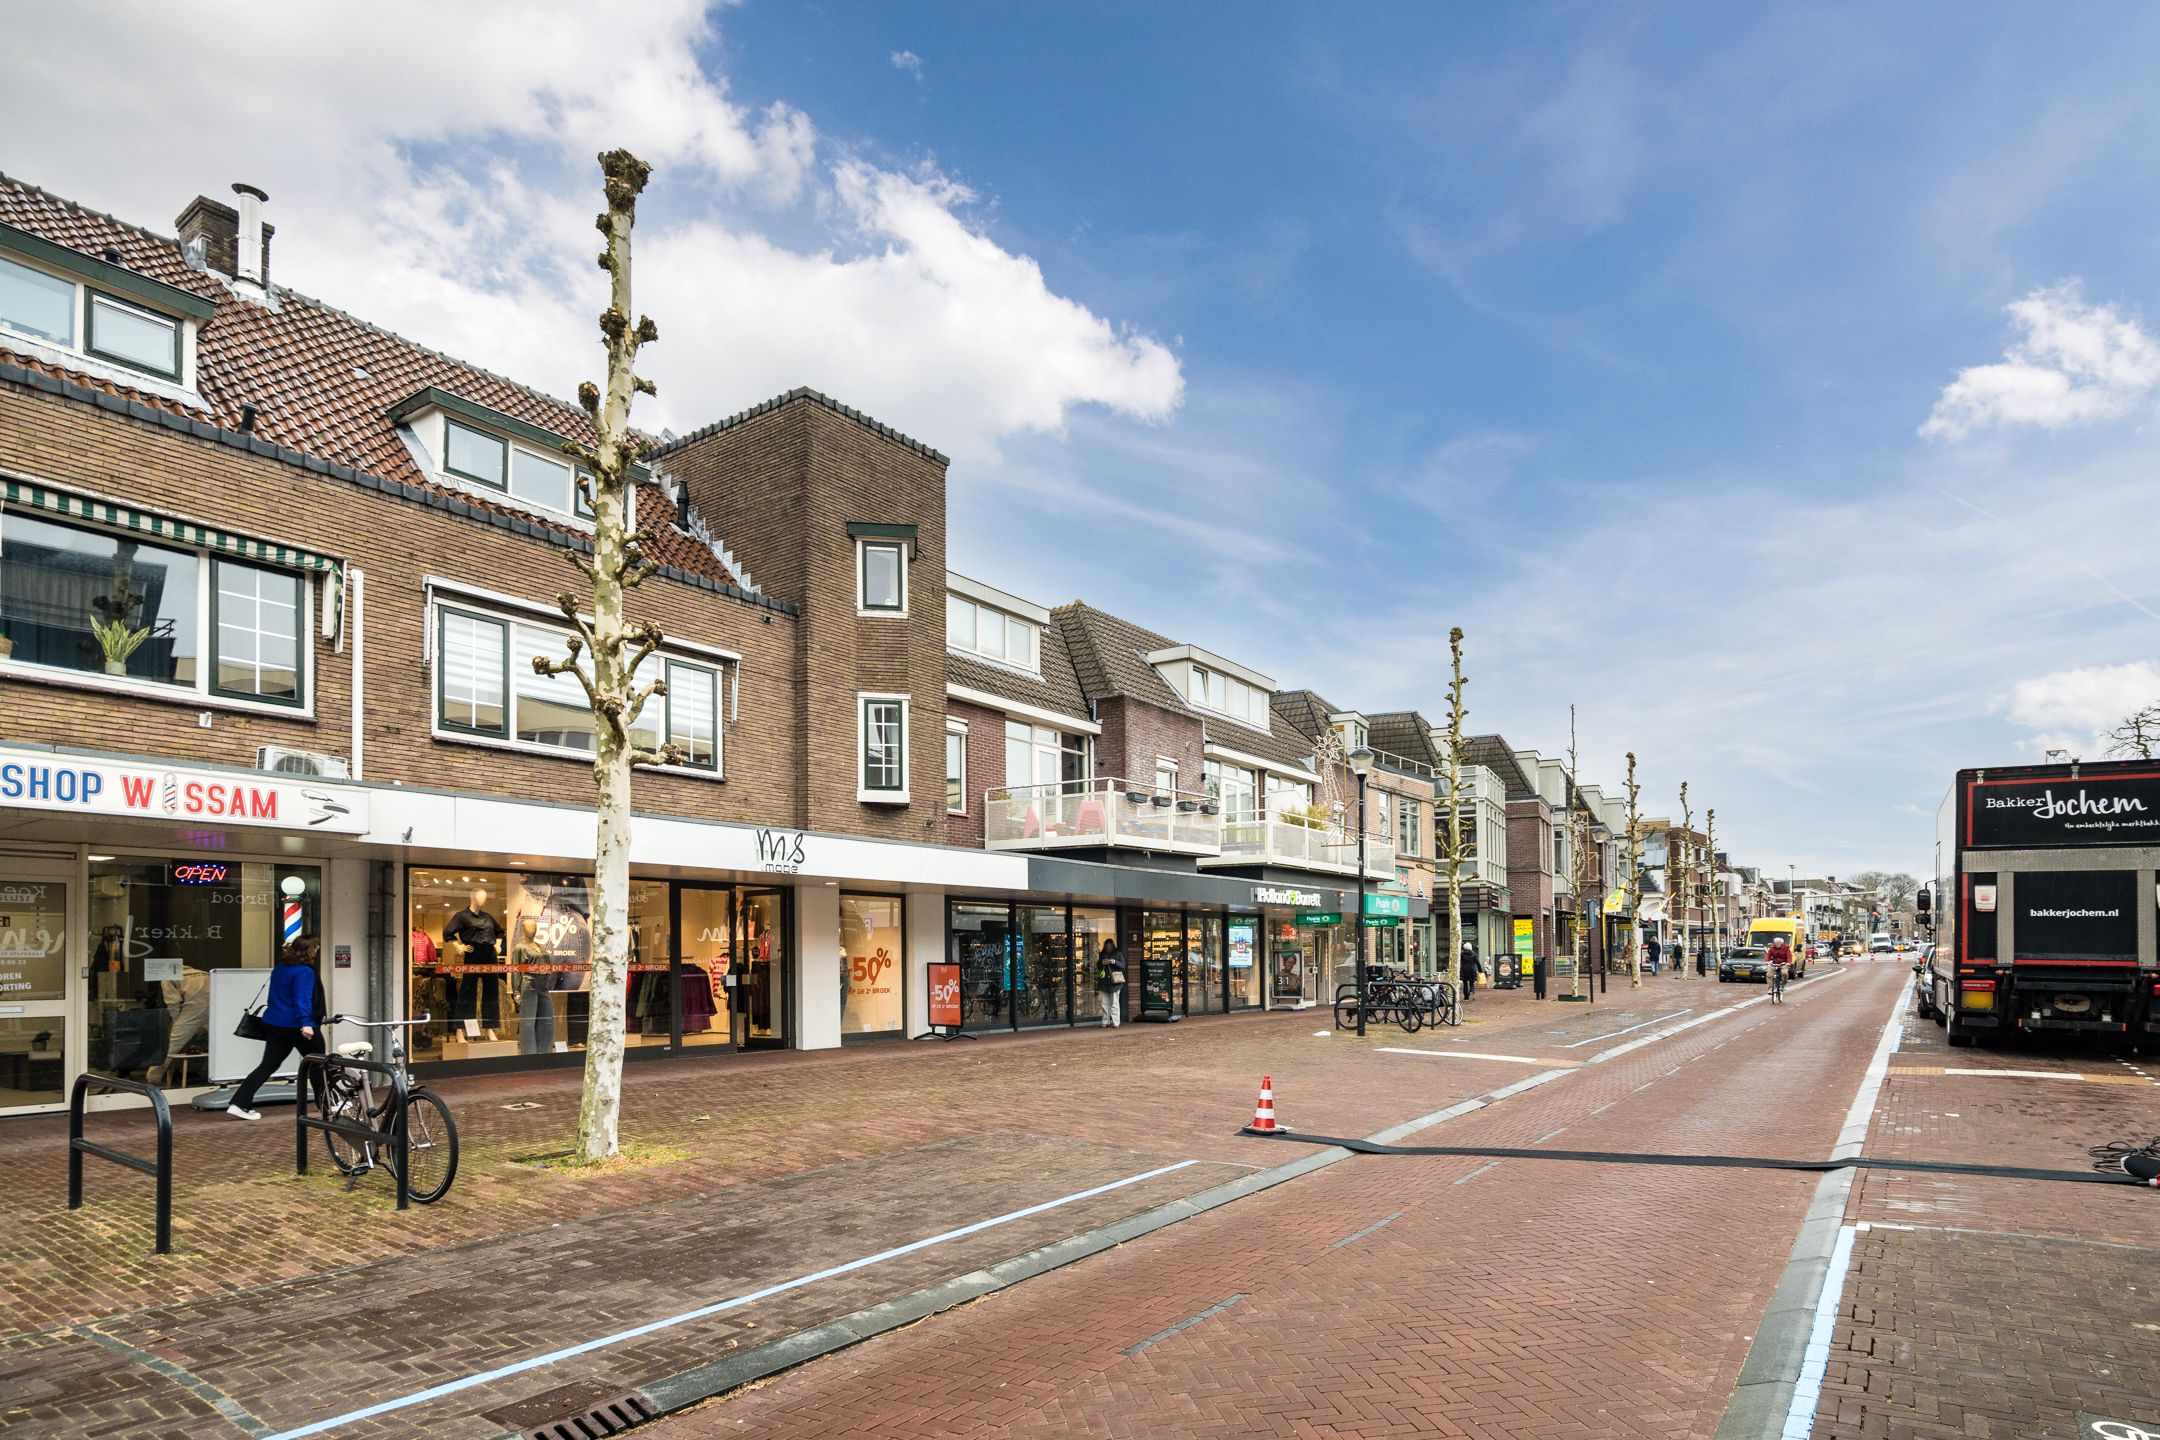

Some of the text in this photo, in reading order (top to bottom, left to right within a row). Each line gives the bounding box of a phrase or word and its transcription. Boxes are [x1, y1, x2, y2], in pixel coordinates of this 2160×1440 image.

[1, 763, 104, 805] SHOP
[1985, 789, 2148, 819] Bakker Jochem
[175, 866, 226, 881] OPEN
[765, 863, 798, 874] mode
[2030, 909, 2119, 919] bakkerjochem.nl
[931, 979, 960, 1003] -50%
